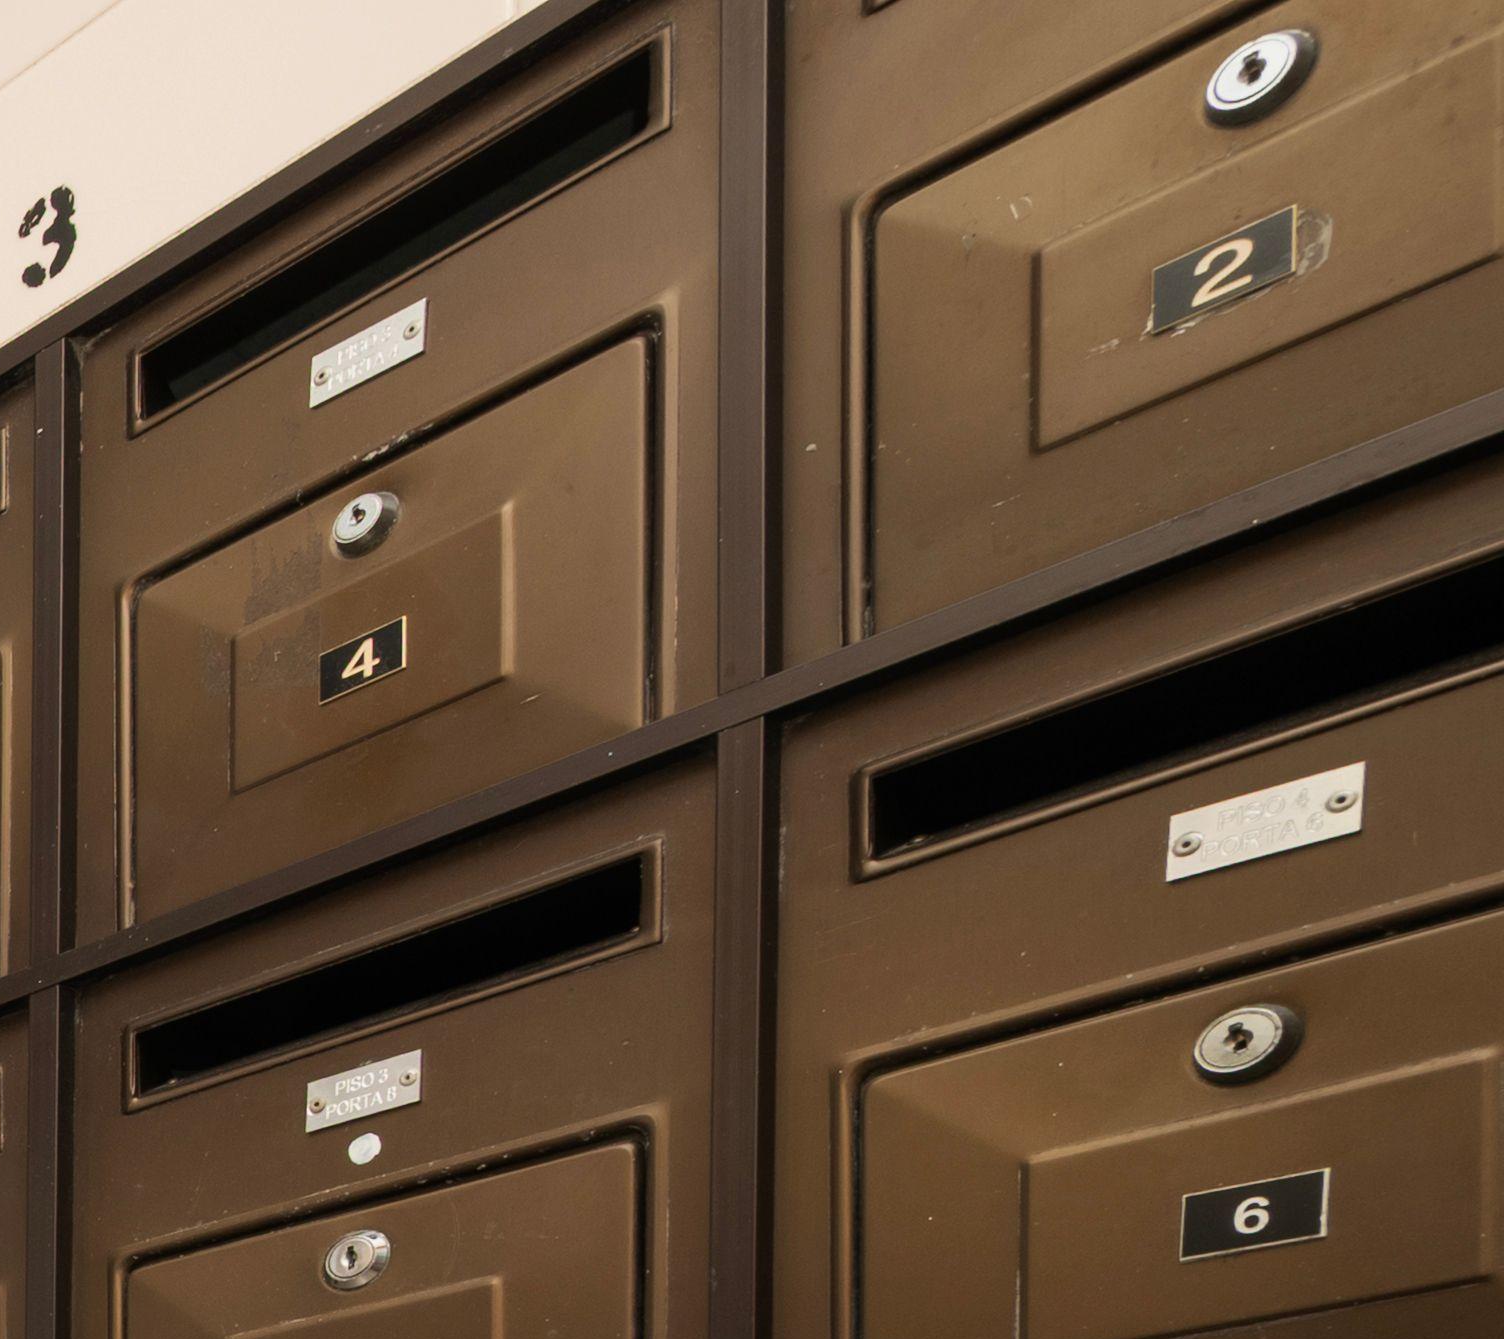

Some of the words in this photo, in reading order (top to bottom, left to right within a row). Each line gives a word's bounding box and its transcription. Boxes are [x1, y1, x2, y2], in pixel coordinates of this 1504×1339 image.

[18, 185, 78, 288] 3
[1191, 237, 1254, 308] 2
[341, 638, 380, 679] 4
[1216, 795, 1286, 831] PISO
[1296, 787, 1310, 808] 4
[1201, 819, 1301, 862] PORTA
[1305, 811, 1325, 833] 6
[334, 1072, 375, 1096] PISO
[377, 1067, 389, 1087] 3
[324, 1092, 383, 1120] PORTA
[1233, 1197, 1270, 1235] 6
